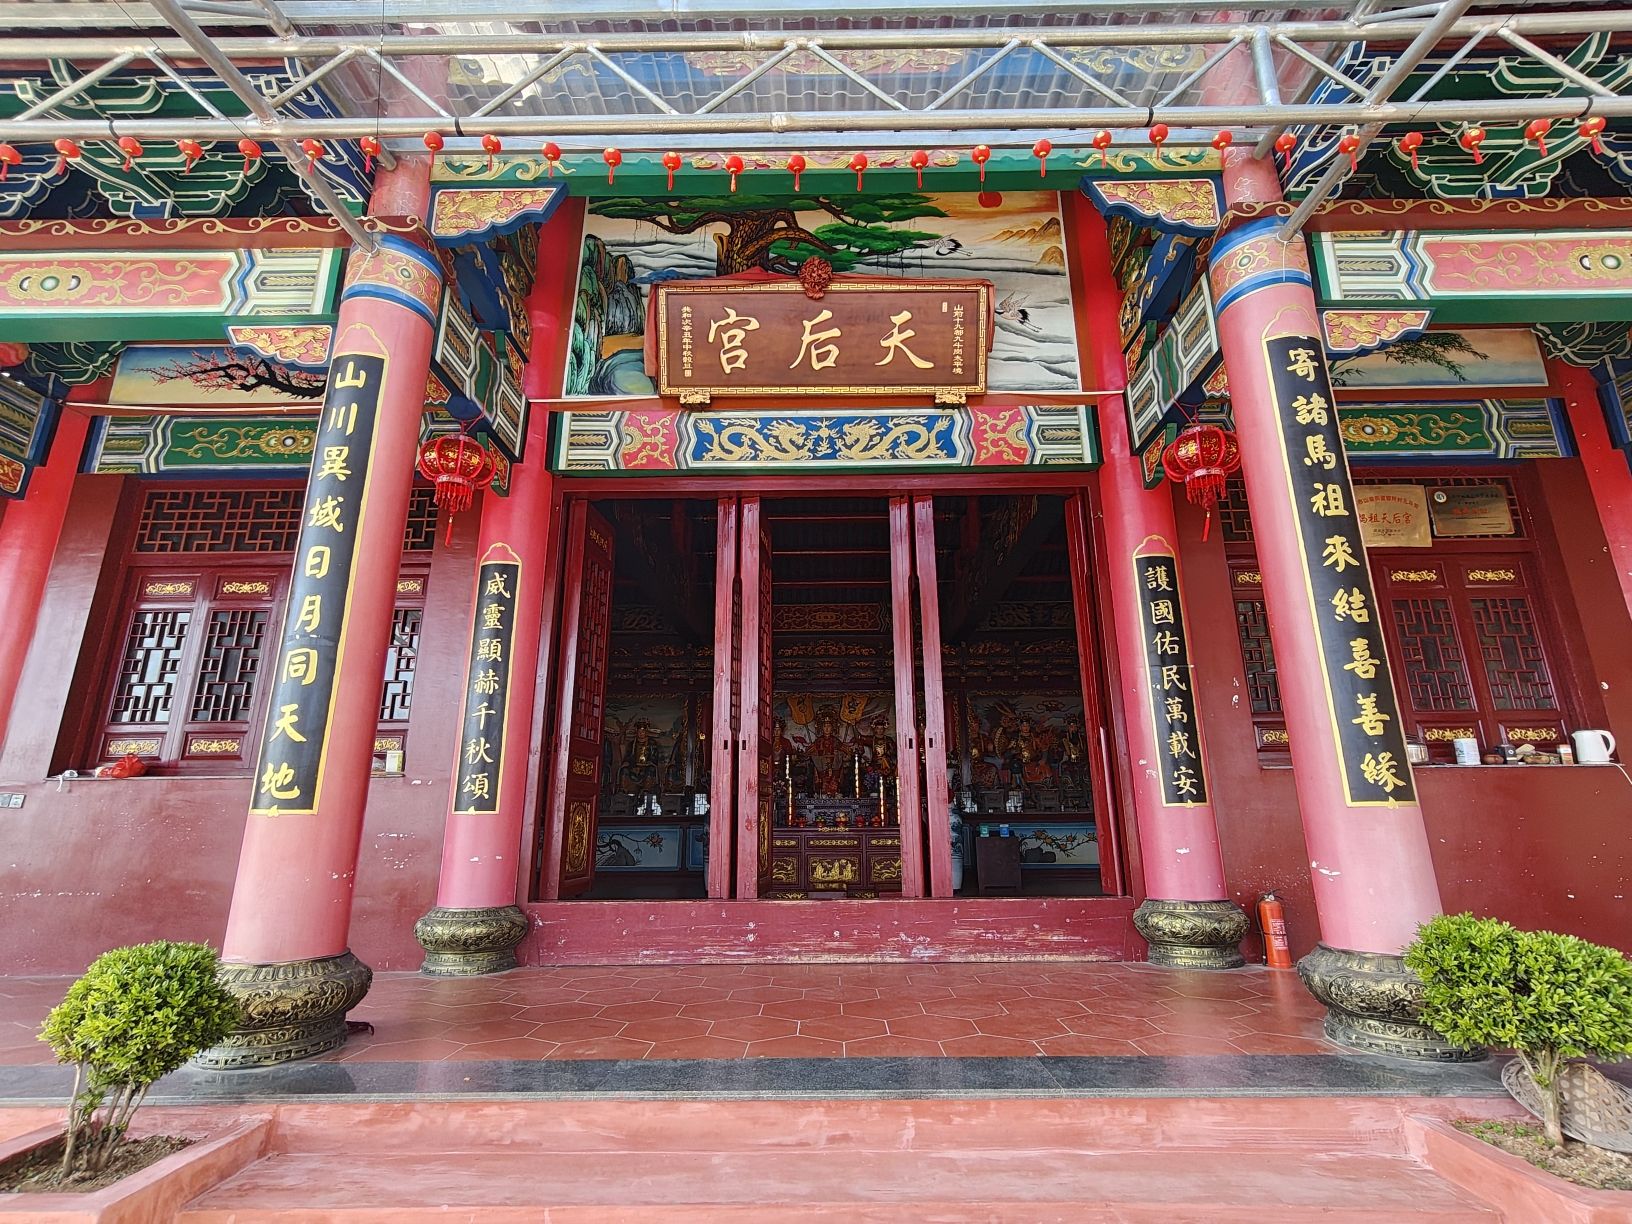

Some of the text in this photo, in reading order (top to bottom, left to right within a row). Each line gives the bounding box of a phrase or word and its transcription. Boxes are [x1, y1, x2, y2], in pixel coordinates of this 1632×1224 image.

[260, 361, 367, 800] 山川異域日月同天地
[462, 572, 511, 800] 威靈顯赫千秋頌
[1144, 565, 1199, 795] 護國佑民萬載安
